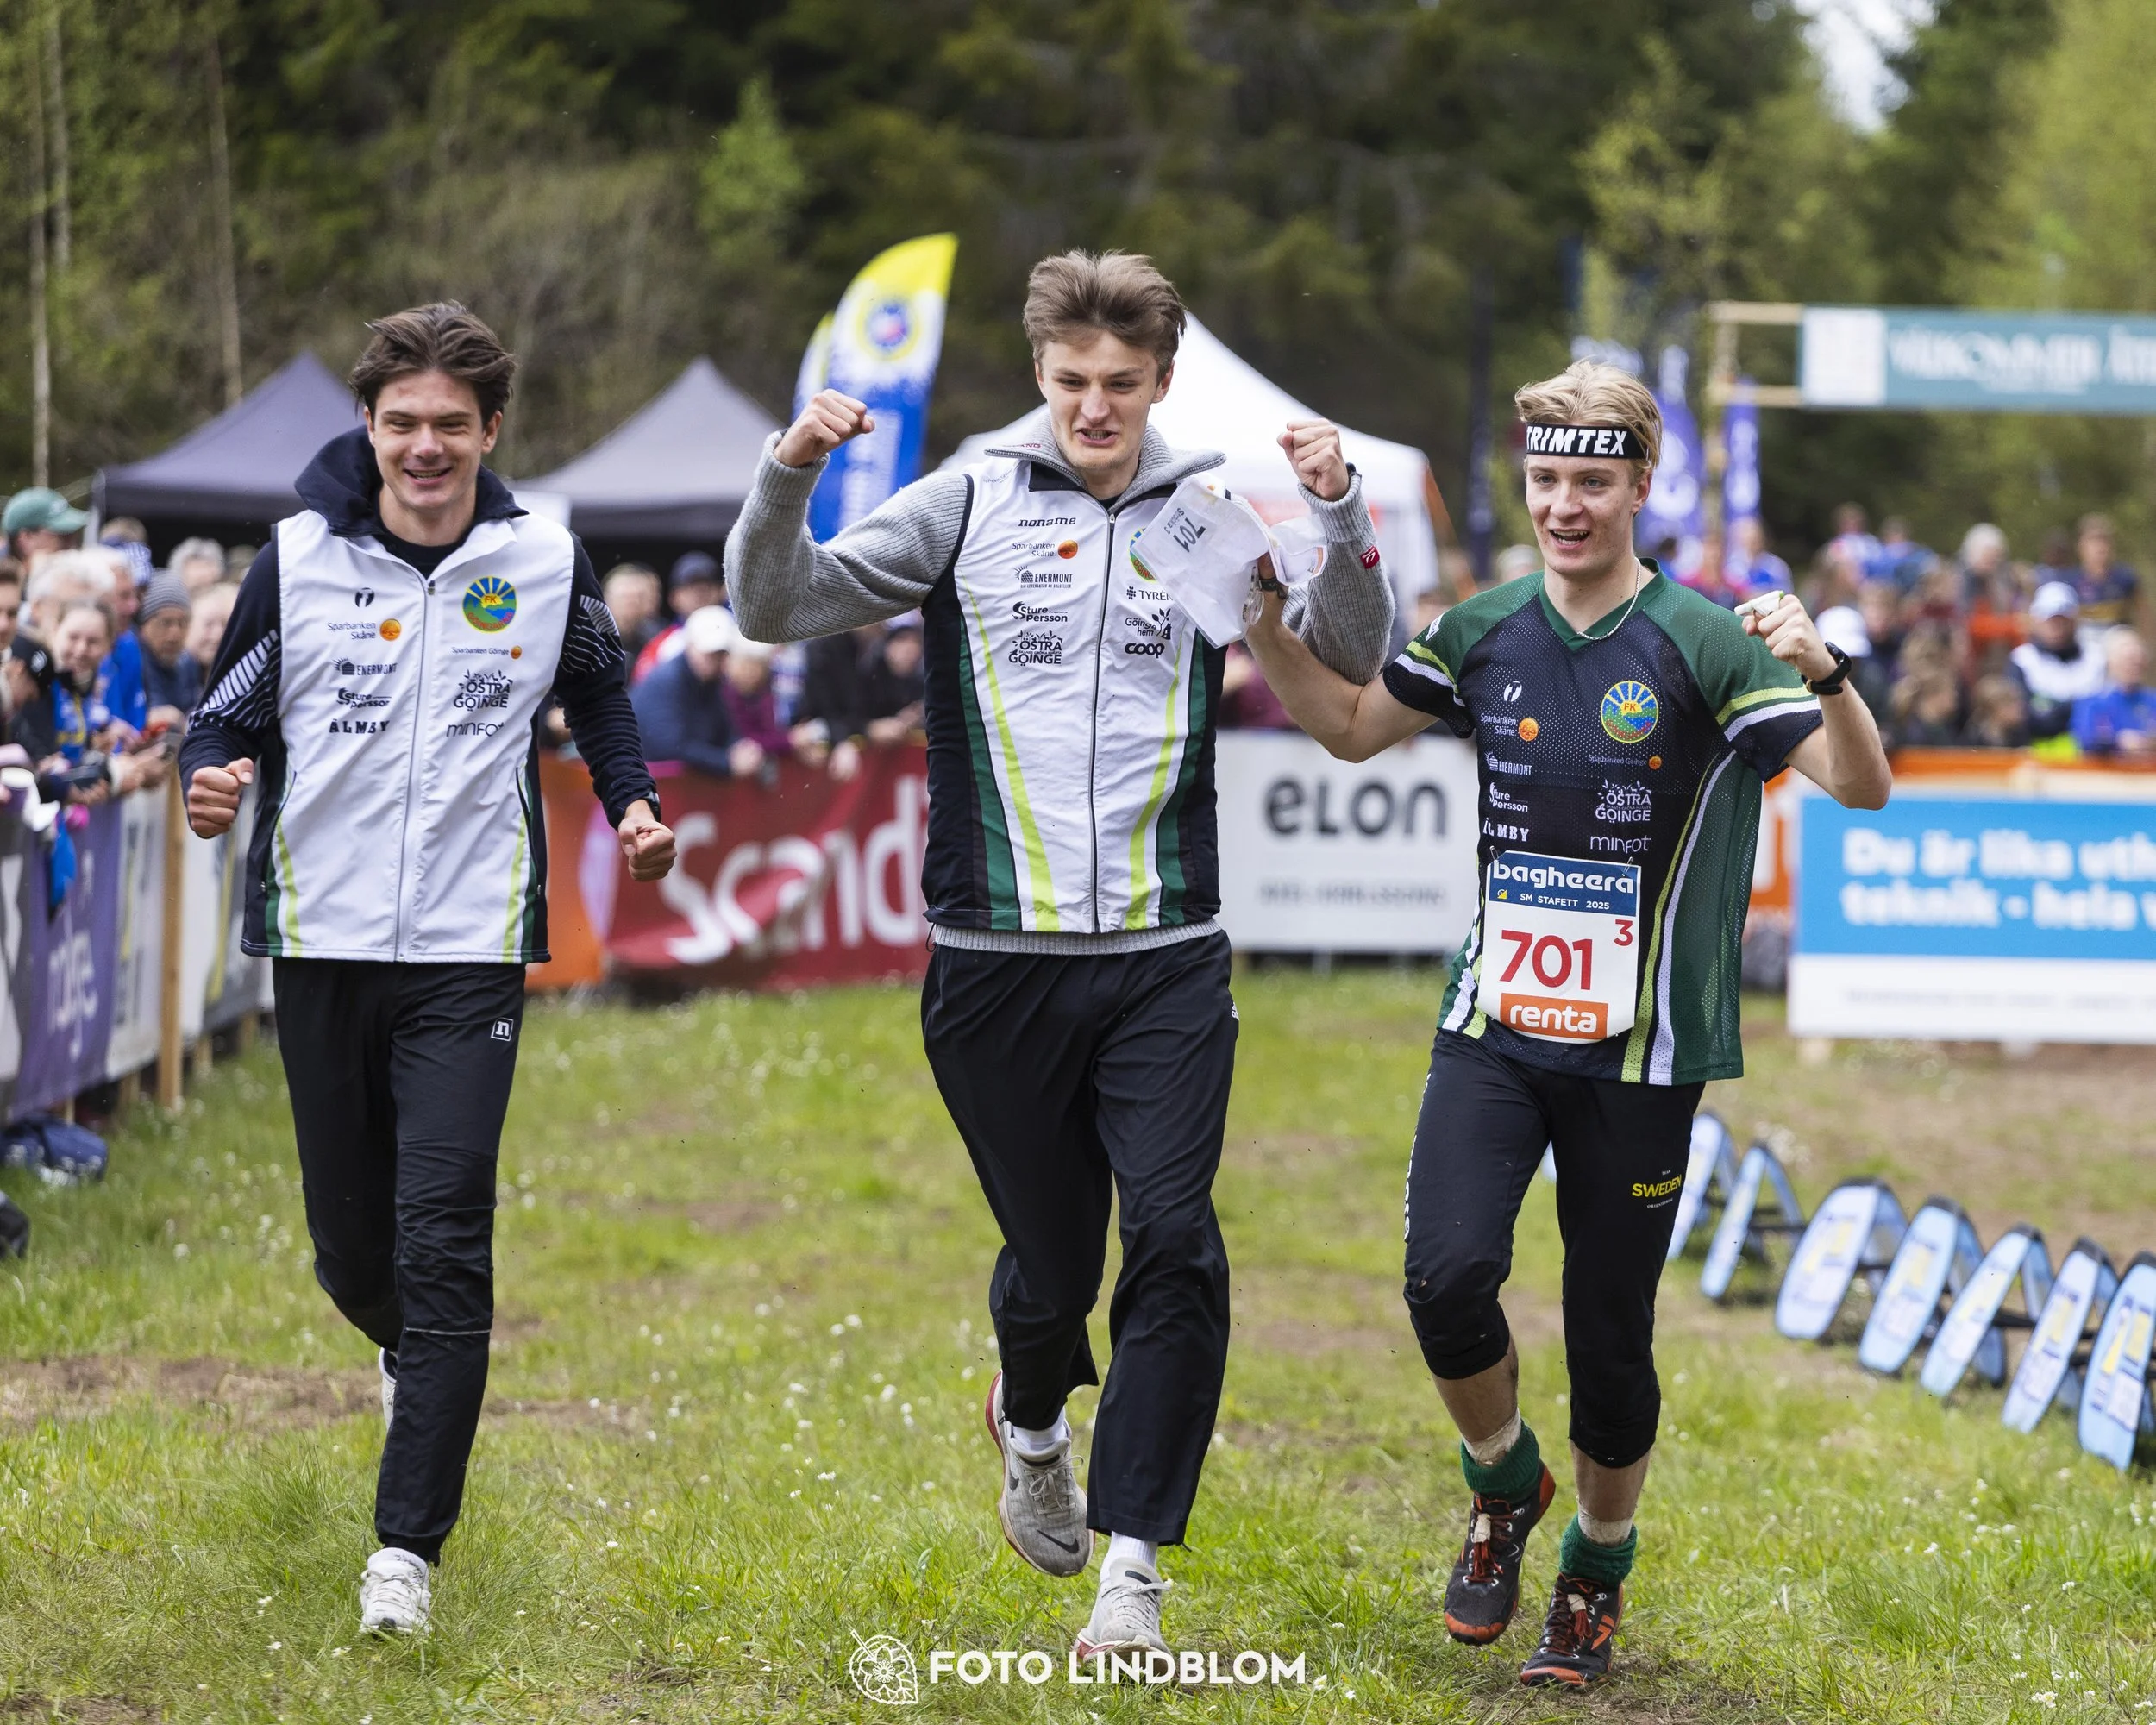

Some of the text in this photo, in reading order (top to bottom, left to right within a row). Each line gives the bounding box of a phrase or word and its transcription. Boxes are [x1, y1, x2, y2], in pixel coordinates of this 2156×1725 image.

[1018, 517, 1076, 527] noname
[1173, 518, 1206, 553] 701
[1012, 542, 1055, 550] Sparbanken
[1034, 573, 1073, 583] ENERMONT
[485, 595, 497, 604] FK
[327, 622, 376, 632] Sparbanken
[1137, 627, 1154, 637] hem
[1125, 643, 1164, 659] coop
[1624, 702, 1637, 712] FK
[1481, 712, 1517, 726] Sparbanken
[1606, 789, 1651, 806] ÖSTRA
[1493, 862, 1633, 894] bagheera
[1520, 893, 1610, 910] SM STAFETT 2025
[1614, 919, 1633, 946] 3
[1499, 929, 1593, 991] 701
[1510, 1005, 1597, 1033] renta
[1632, 1174, 1682, 1197] SWEDEN
